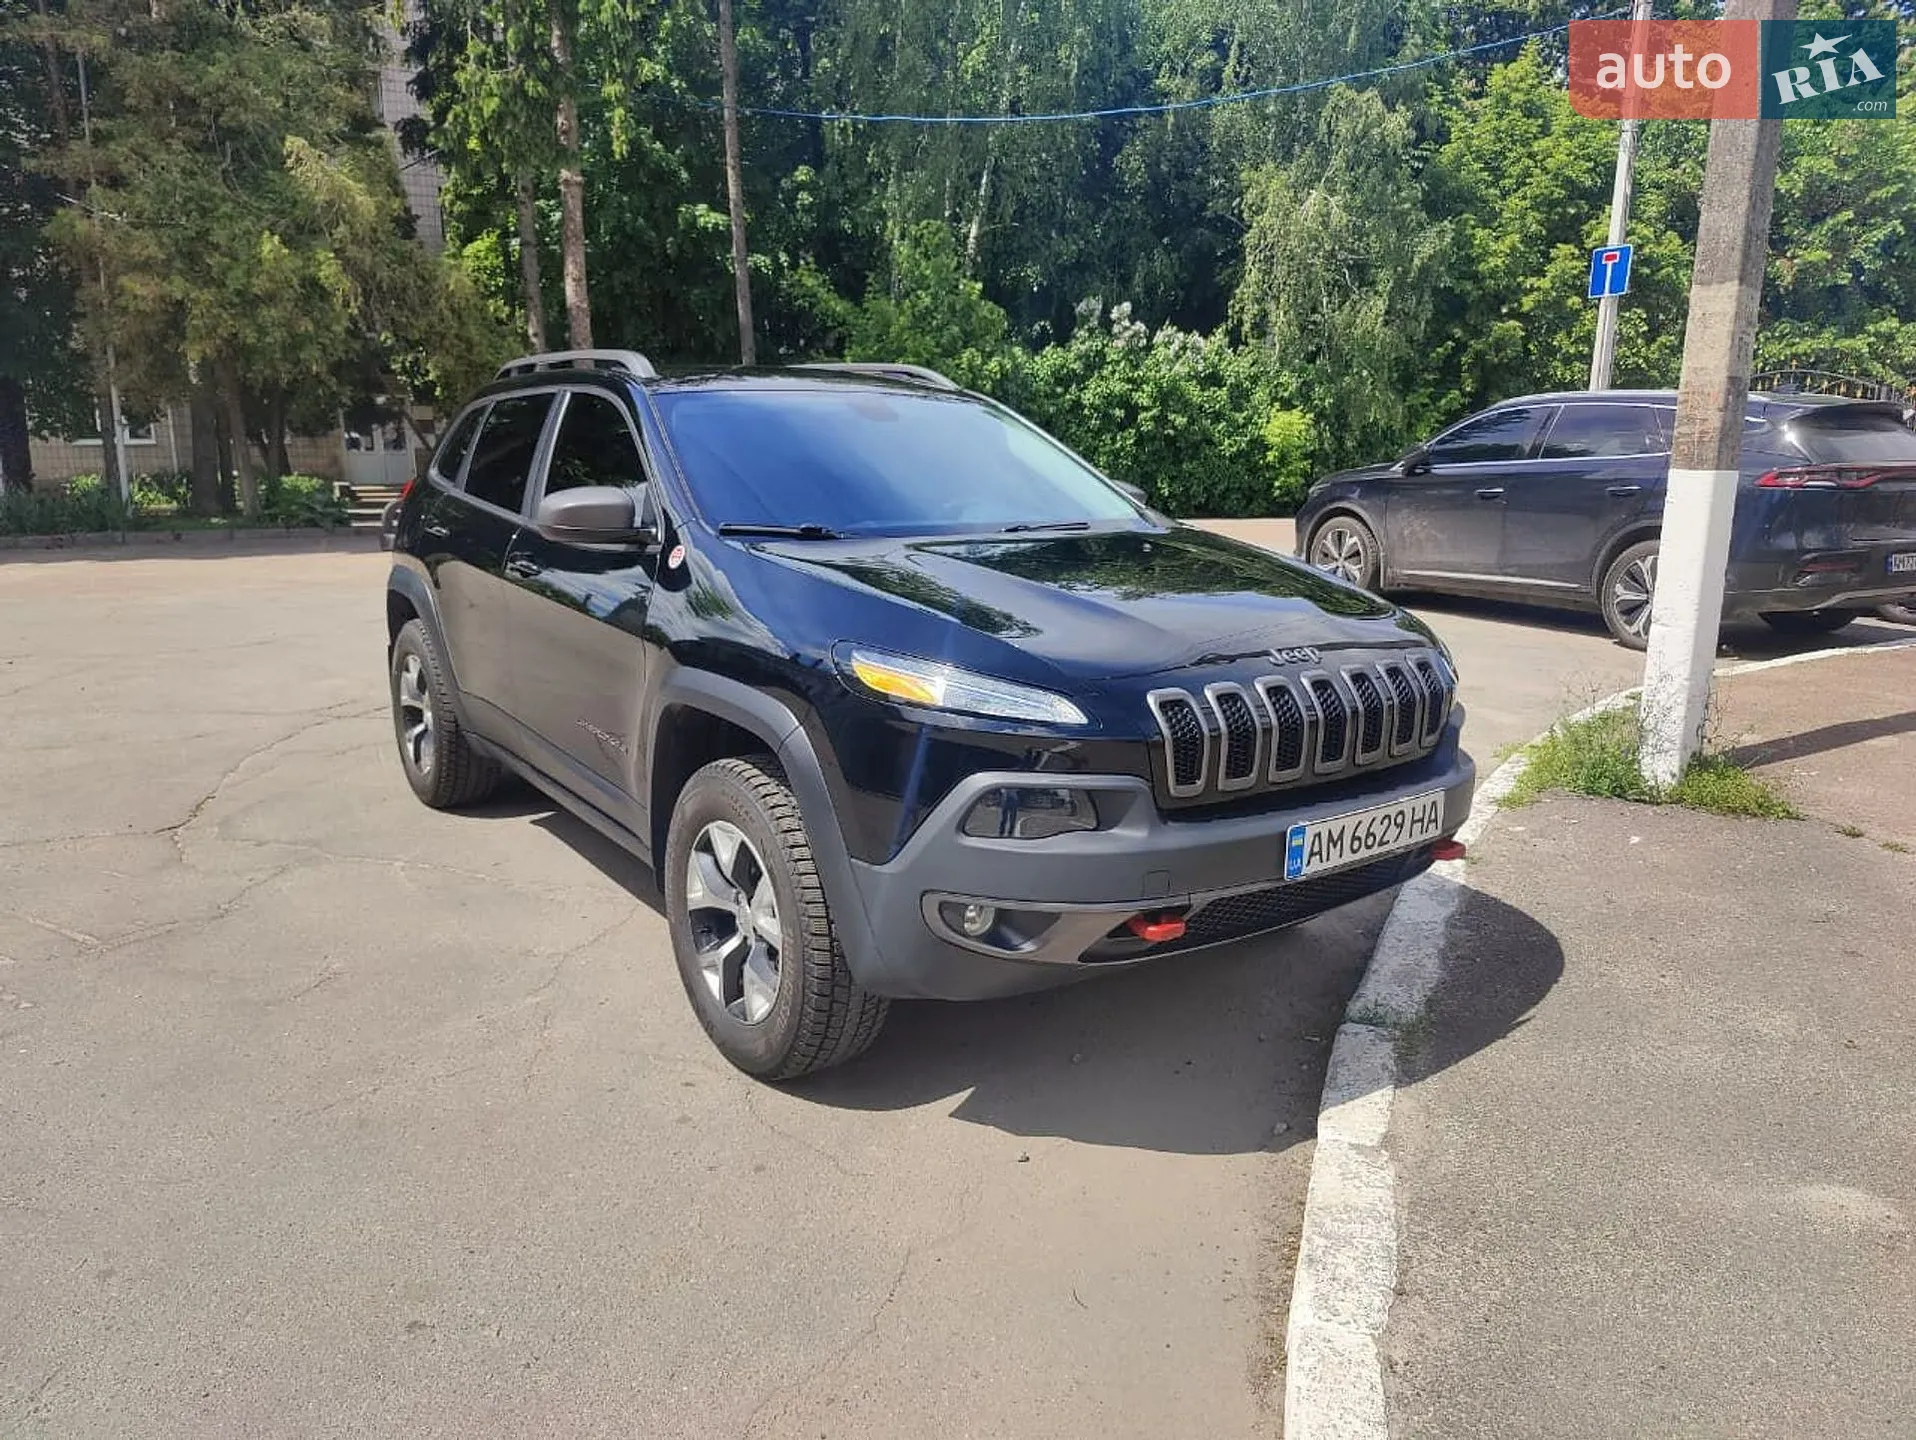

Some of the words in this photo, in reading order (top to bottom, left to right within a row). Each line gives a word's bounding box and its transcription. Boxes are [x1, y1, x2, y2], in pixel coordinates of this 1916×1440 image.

[1268, 647, 1322, 666] Jeep
[1305, 825, 1346, 867] AM
[1349, 809, 1406, 855] 6629
[1408, 800, 1439, 839] HA
